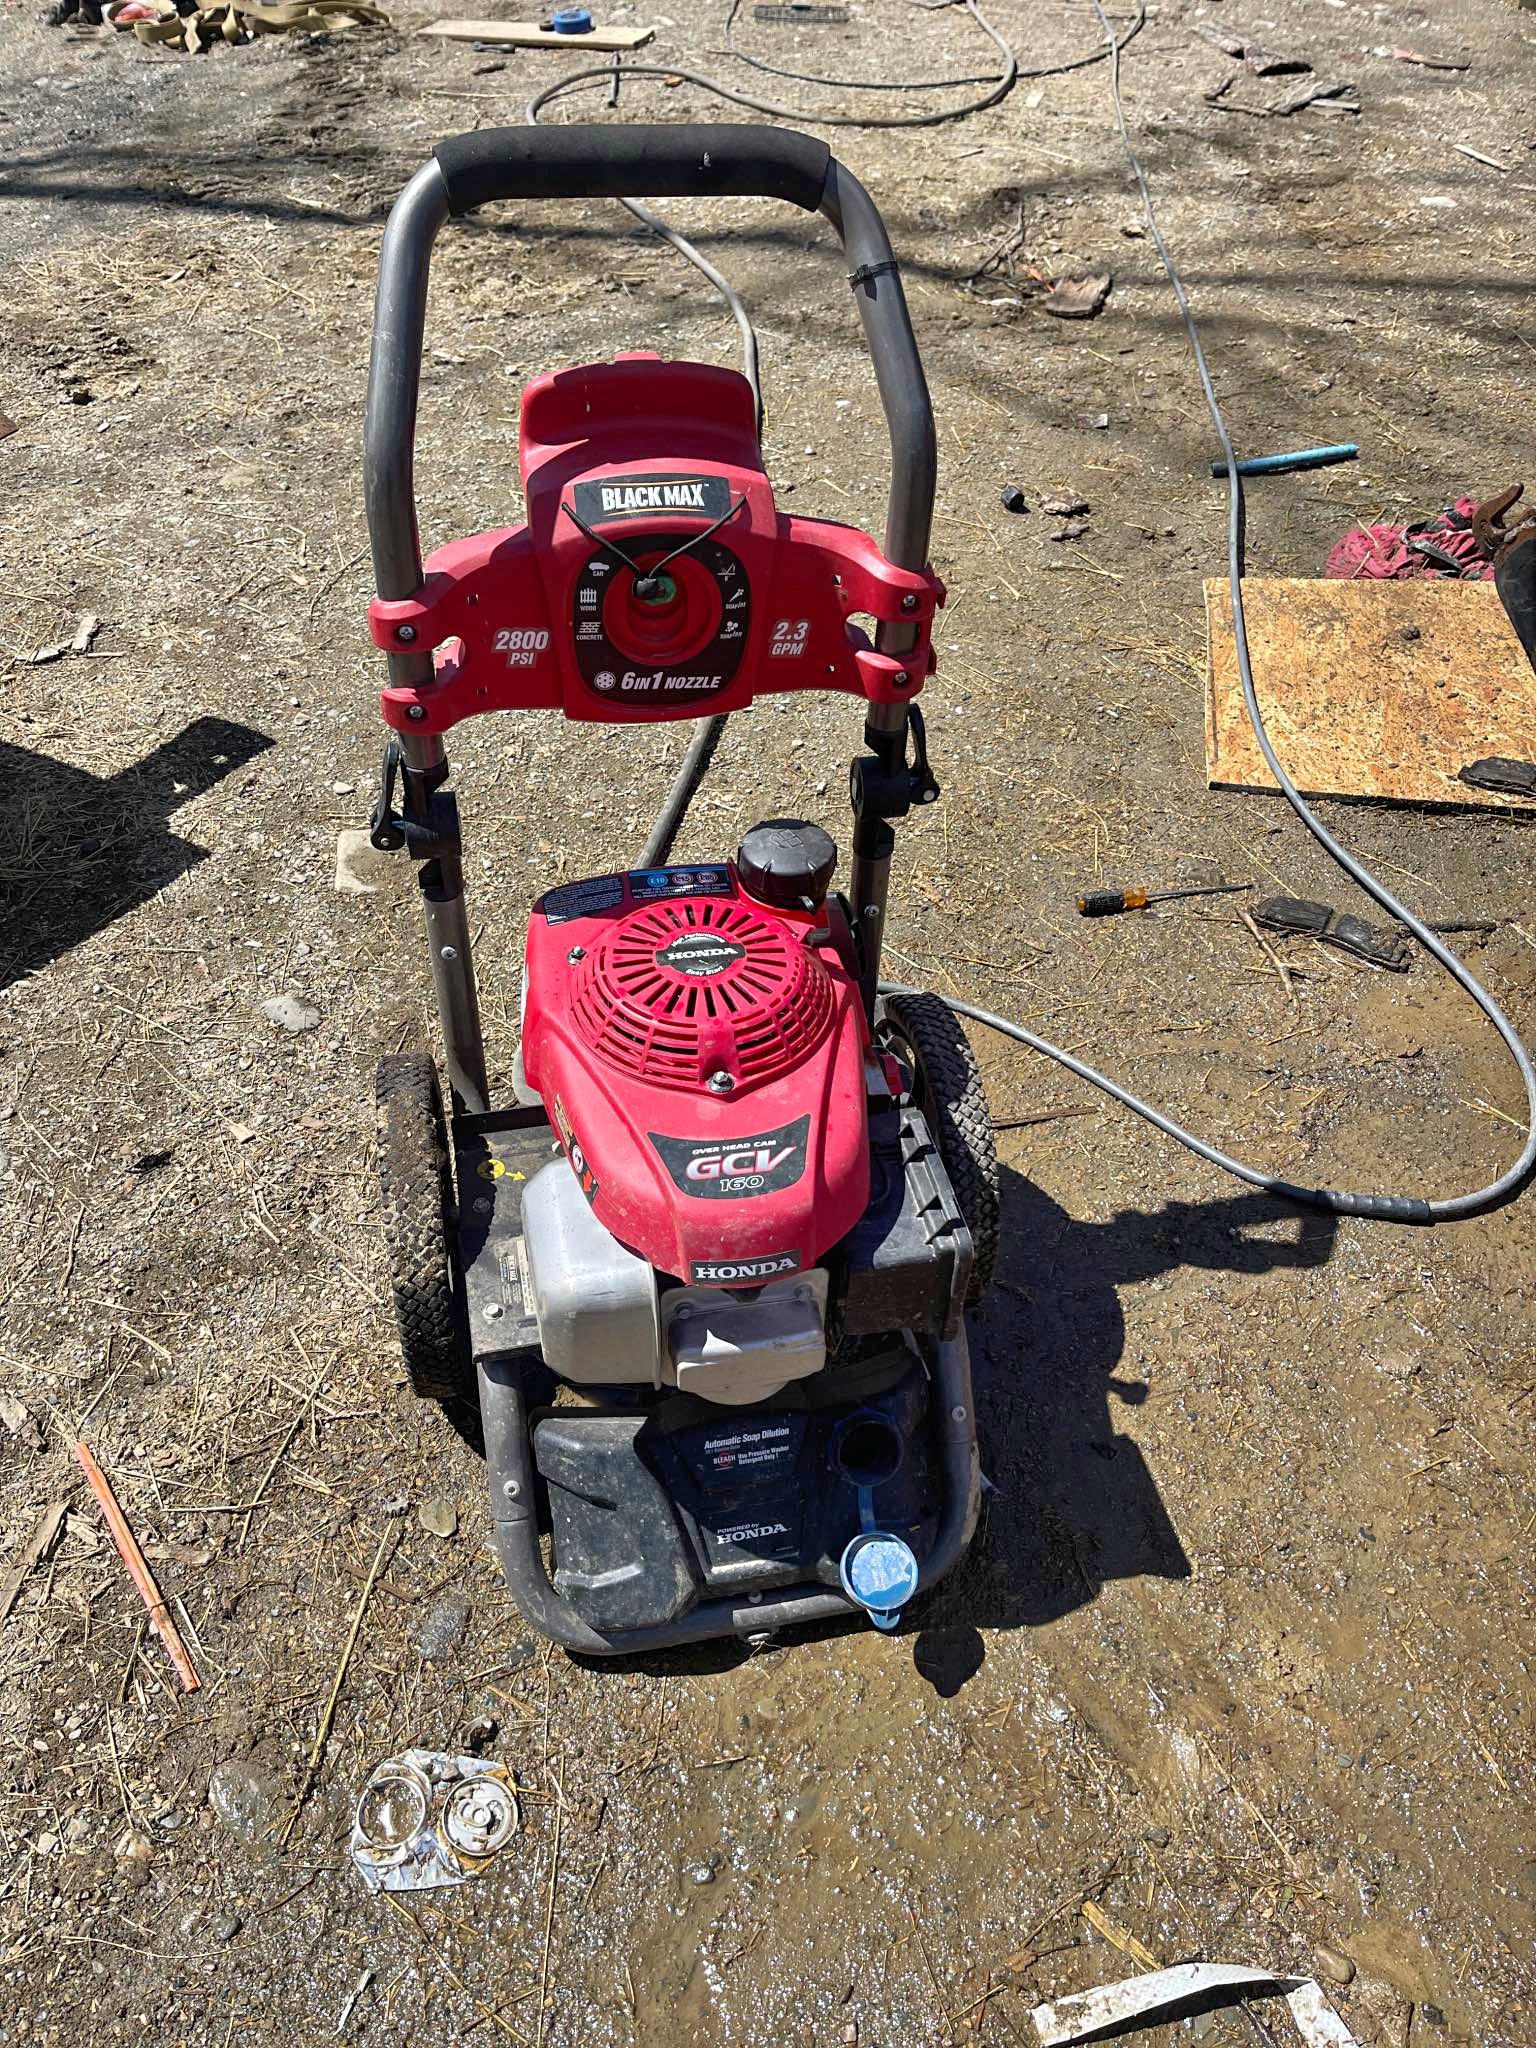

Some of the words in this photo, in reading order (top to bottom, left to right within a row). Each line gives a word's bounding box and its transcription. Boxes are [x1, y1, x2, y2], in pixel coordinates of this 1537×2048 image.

[601, 486, 662, 511] BLACK
[663, 483, 705, 507] MAX
[495, 630, 549, 650] 2800
[773, 622, 808, 640] 2.3
[772, 642, 804, 656] GPM
[510, 652, 535, 665] PSI
[664, 675, 722, 690] NOZZLE
[667, 947, 739, 961] HONDA
[685, 968, 705, 977] Easy
[705, 965, 725, 976] Start
[691, 1146, 720, 1155] OVER
[722, 1142, 751, 1151] HEAD
[753, 1139, 777, 1148] CAM
[686, 1146, 798, 1181] GCV
[719, 1174, 764, 1192] 160
[695, 1257, 798, 1279] HONDA
[704, 1435, 742, 1450] Automatic
[742, 1432, 761, 1443] Soap
[761, 1427, 790, 1440] Dilution
[713, 1454, 736, 1465] BLEACH
[748, 1449, 771, 1458] Pressure
[771, 1445, 790, 1455] Washer
[738, 1456, 764, 1465] Detergent
[716, 1523, 788, 1545] HONDA
[717, 1524, 751, 1534] POWERED
